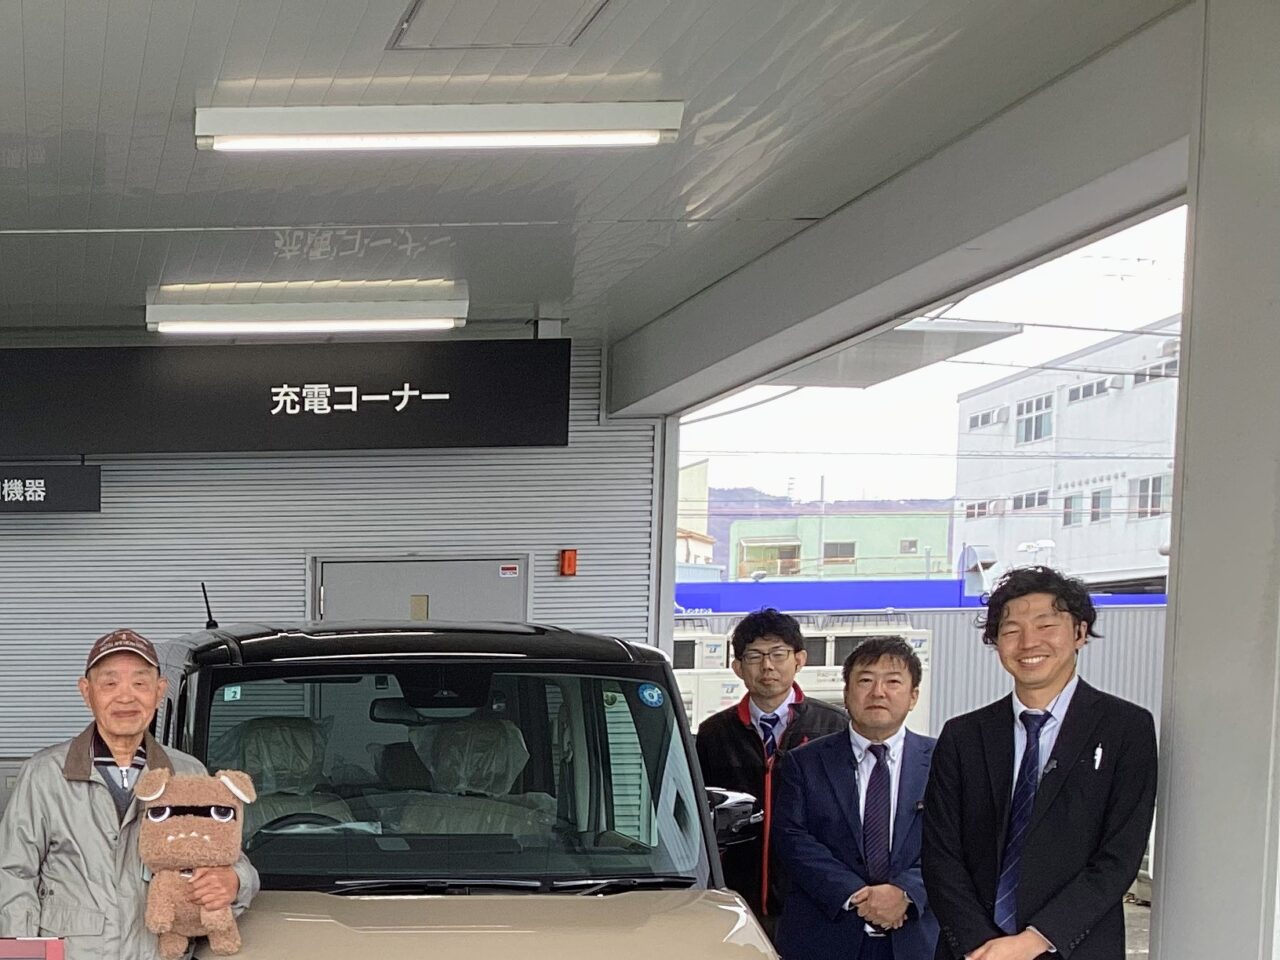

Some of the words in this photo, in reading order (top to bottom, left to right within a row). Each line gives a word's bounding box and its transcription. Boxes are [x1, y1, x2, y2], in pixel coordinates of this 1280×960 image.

[270, 382, 450, 415] 充電コーナー
